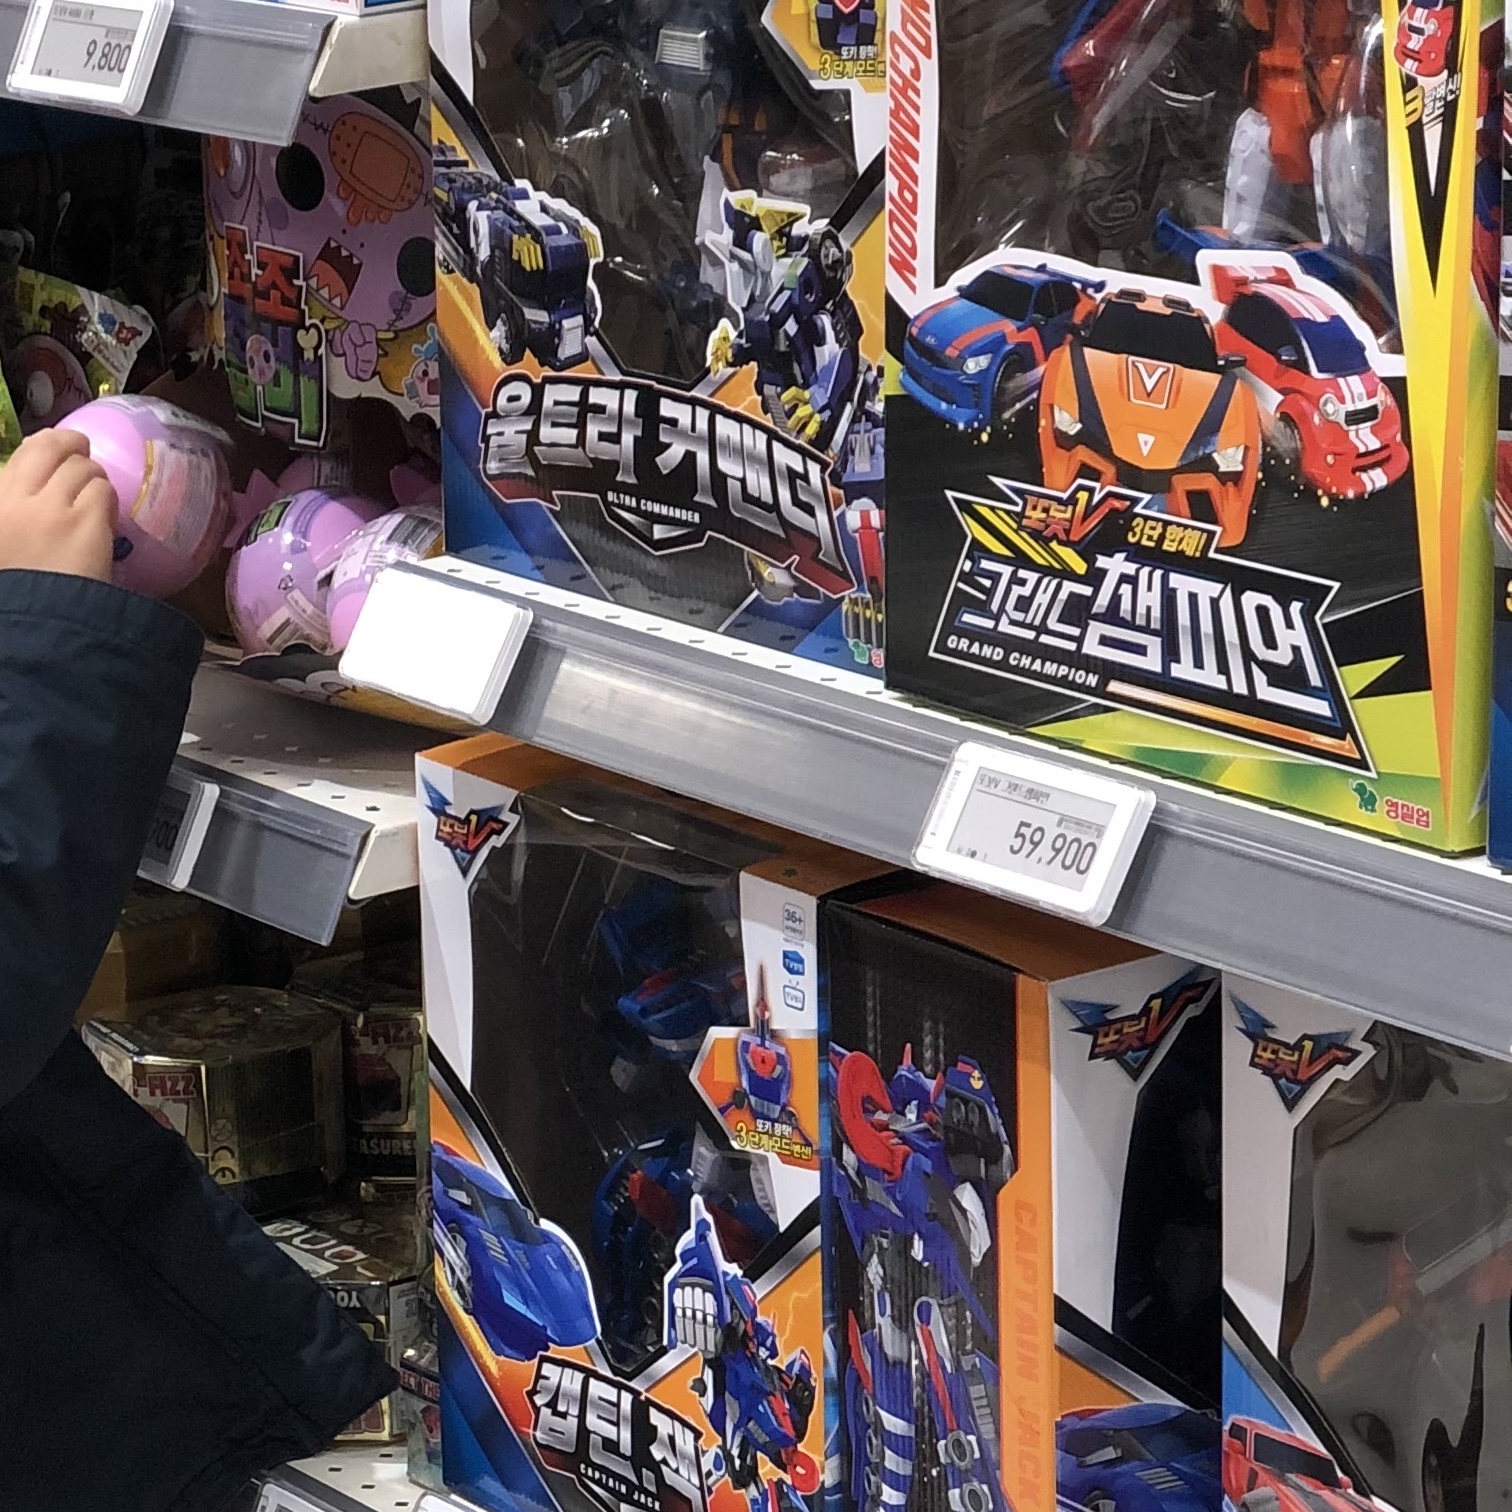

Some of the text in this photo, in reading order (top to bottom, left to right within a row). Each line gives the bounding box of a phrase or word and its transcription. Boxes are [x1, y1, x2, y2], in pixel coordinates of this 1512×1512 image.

[84, 39, 132, 74] 9.800
[855, 60, 877, 78] 모드
[888, 30, 921, 293] CHAMPION
[486, 380, 844, 572] 울트라 커맨더
[607, 491, 700, 523] ULTRA COMMANDER
[946, 635, 1100, 688] GRAND CHAMPION
[1009, 821, 1097, 875] 59.900
[784, 909, 803, 925] 36+
[146, 1073, 196, 1099] FIZZ
[770, 1136, 792, 1154] 모드
[1014, 1200, 1042, 1505] CAPTAIN JACK
[579, 1463, 660, 1511] CAPTAIN JACK
